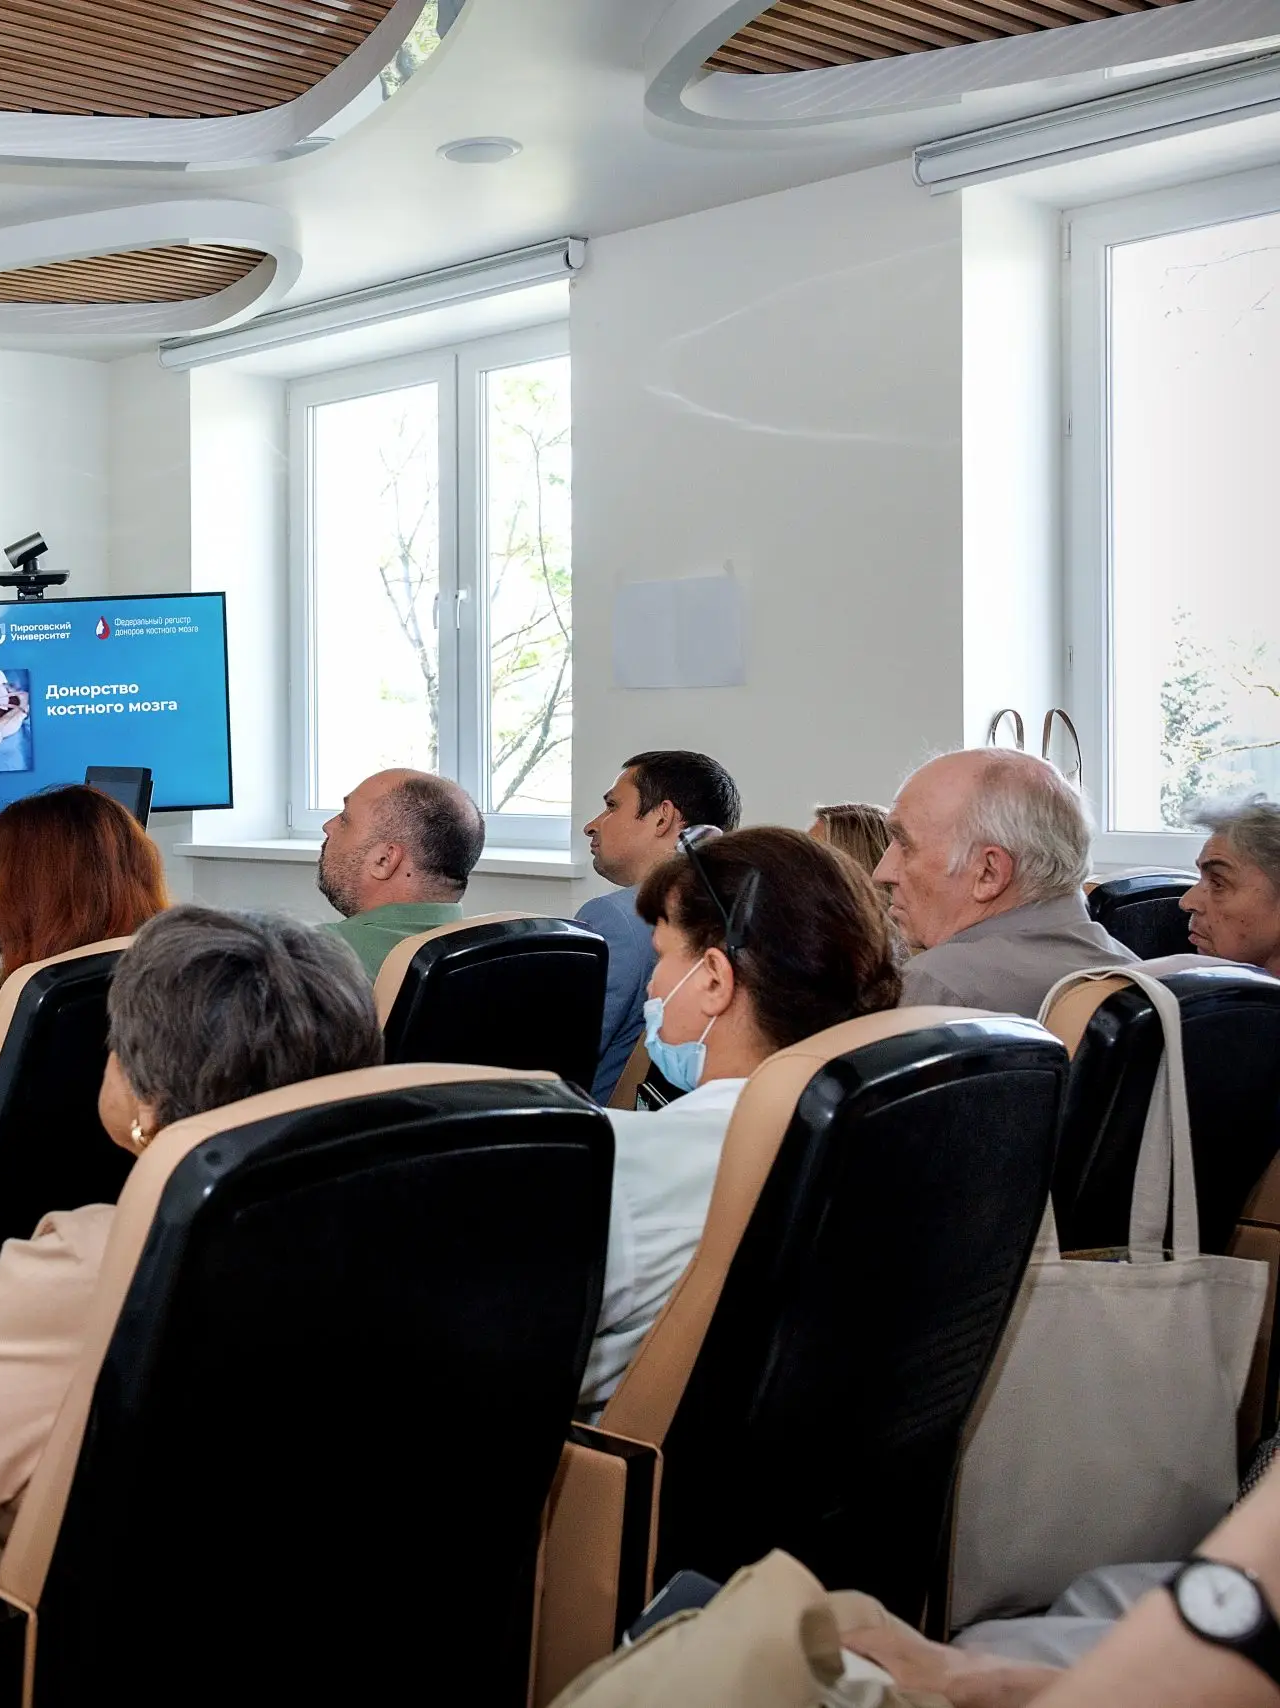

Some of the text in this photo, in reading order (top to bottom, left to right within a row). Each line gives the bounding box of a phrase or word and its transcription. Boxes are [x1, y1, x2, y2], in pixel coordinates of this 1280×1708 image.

[10, 621, 72, 633] Пироговский
[114, 616, 191, 627] Федеральный регистр
[10, 632, 71, 642] Университет
[115, 625, 199, 637] доноров костного мозга
[45, 683, 139, 699] Донорство
[47, 700, 178, 716] костного мозга
